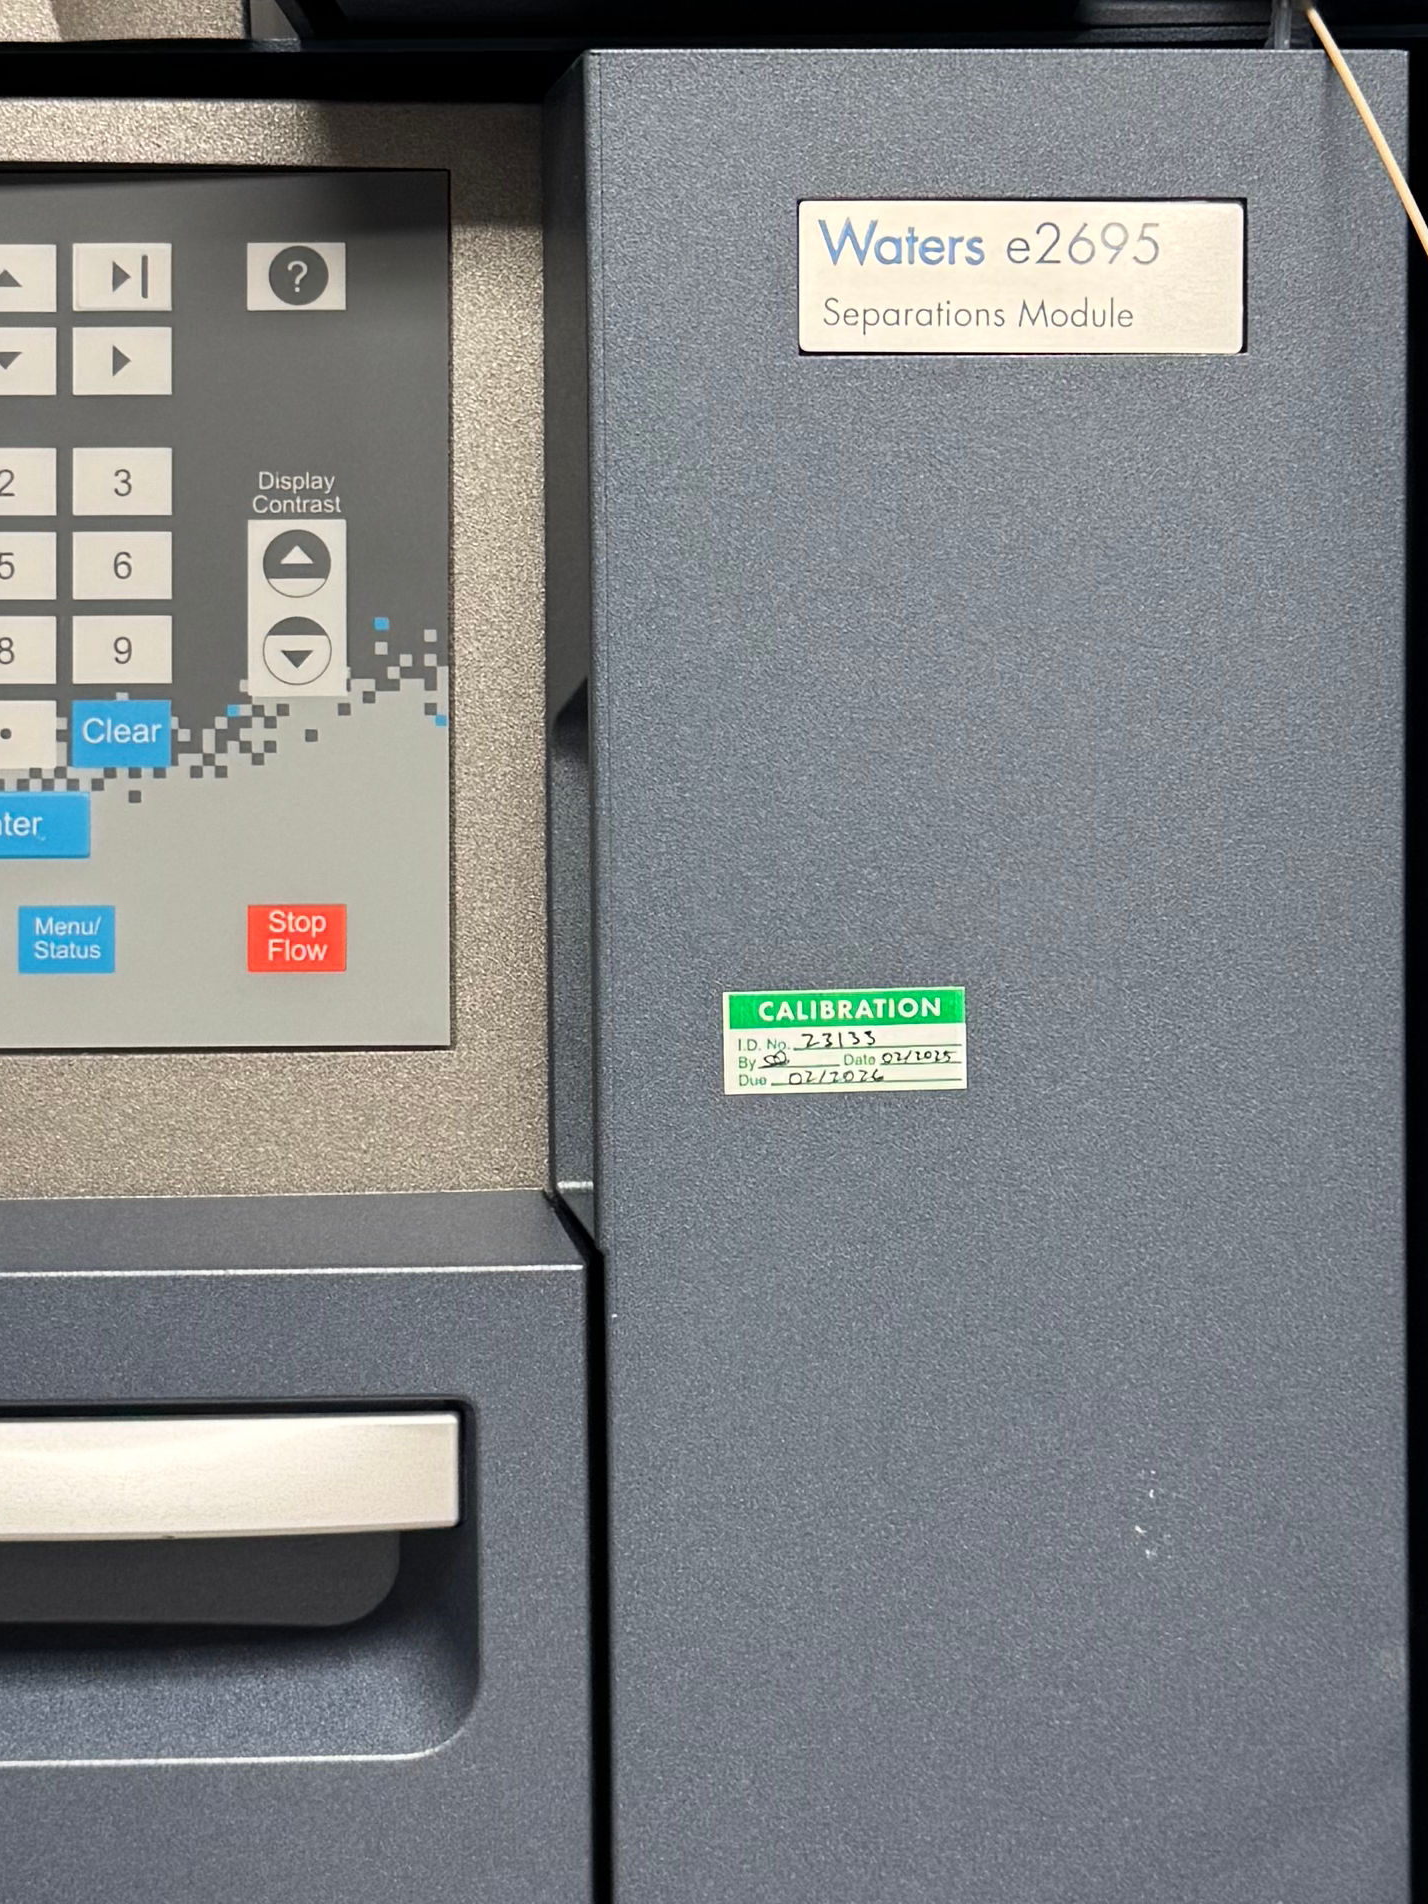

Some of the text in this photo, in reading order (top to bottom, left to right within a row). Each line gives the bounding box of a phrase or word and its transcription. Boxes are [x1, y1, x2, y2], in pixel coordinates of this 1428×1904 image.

[817, 217, 1160, 267] Waters e2695
[823, 296, 1134, 336] Separations Module
[113, 468, 133, 498] 3
[258, 471, 336, 495] Display
[252, 494, 342, 514] Contrast
[113, 551, 133, 581] 6
[113, 636, 133, 665] 9
[81, 717, 162, 746] Clear
[34, 916, 102, 937] Menu/
[268, 909, 327, 938] Stop
[33, 939, 102, 960] Status
[267, 938, 329, 961] Flow
[758, 997, 942, 1022] CALIBRATION
[737, 1038, 791, 1052] I.D. No.
[738, 1056, 757, 1072] By
[843, 1053, 876, 1066] Date
[881, 1049, 957, 1066] 02/2025
[738, 1074, 768, 1087] Due
[788, 1068, 885, 1086] 02/2026
